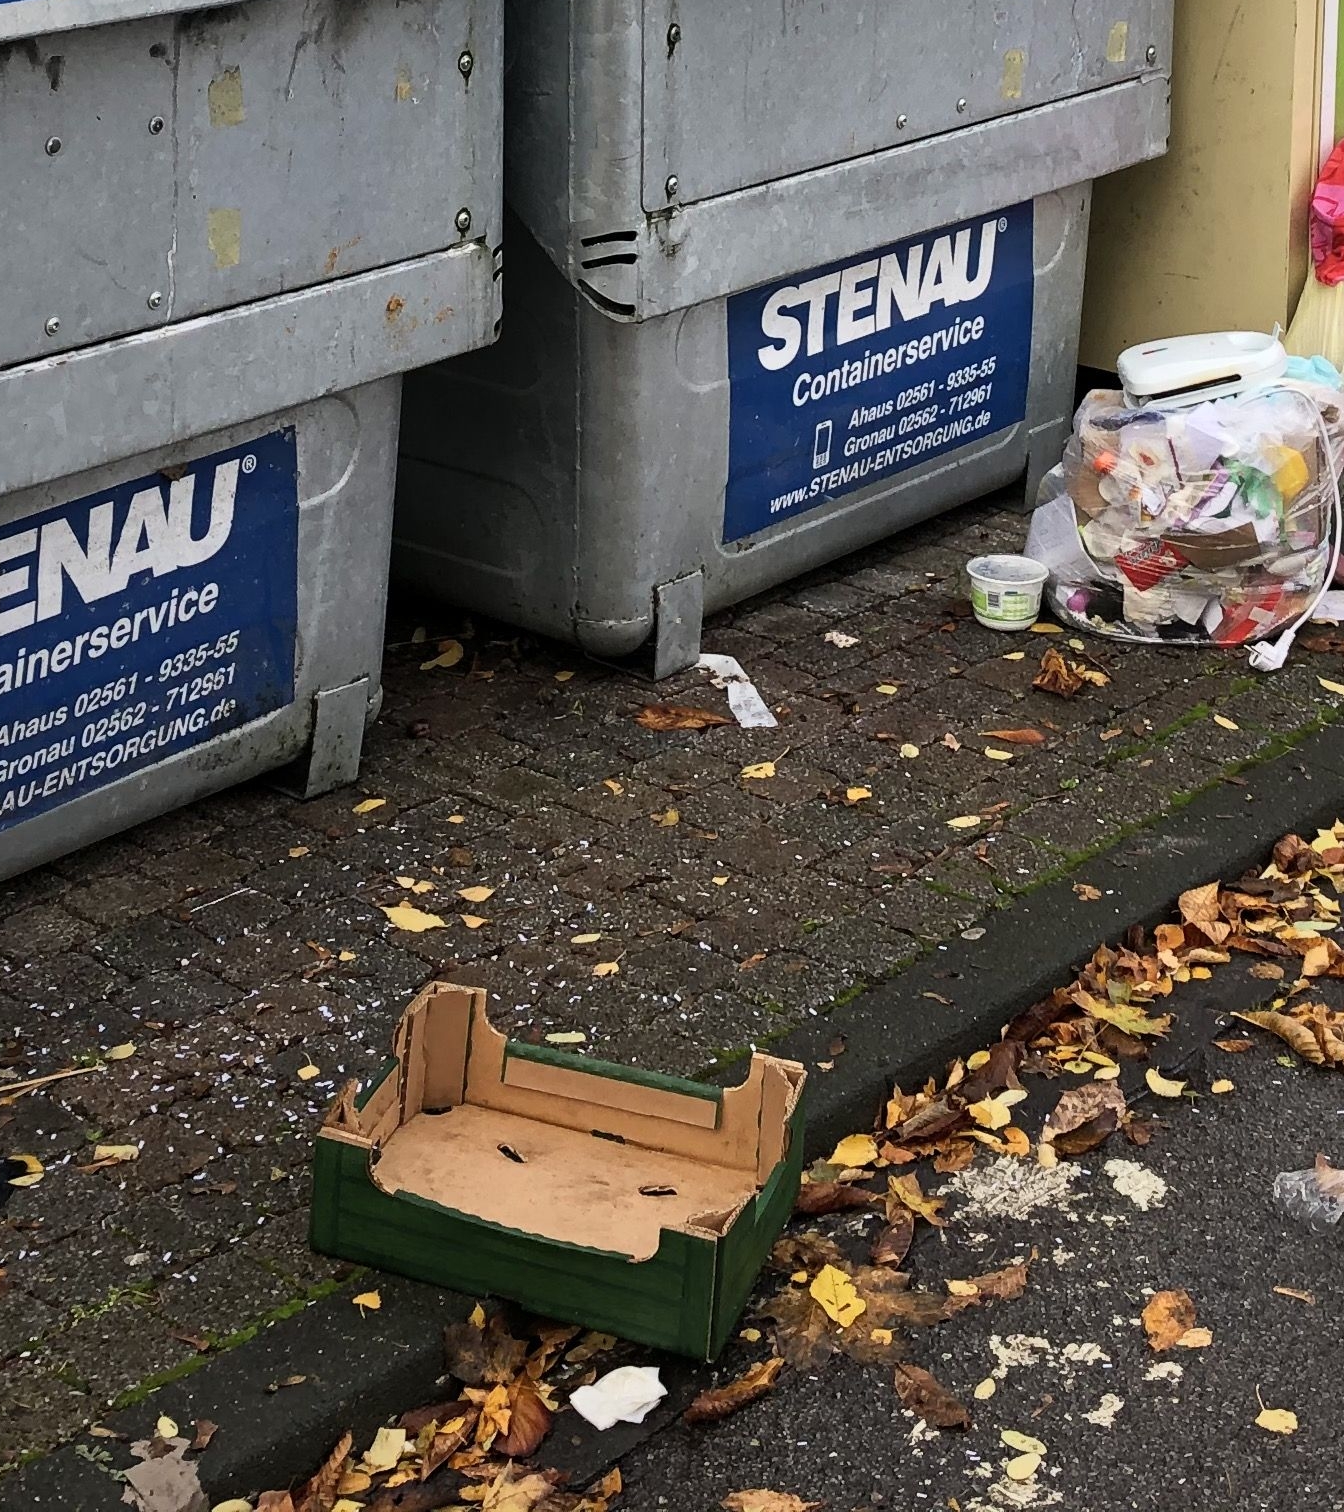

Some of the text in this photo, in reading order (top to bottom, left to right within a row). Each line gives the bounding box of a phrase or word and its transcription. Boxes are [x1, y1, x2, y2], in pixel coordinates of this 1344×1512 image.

[792, 315, 985, 408] Containerservice
[848, 399, 894, 430] Ahaus
[896, 379, 936, 411] 02561
[946, 355, 997, 392] 9335-55
[770, 410, 991, 514] www.STENAU-ENTSORGUNG.de
[844, 424, 895, 457] Gronau
[898, 404, 939, 436] 02562
[948, 381, 993, 416] 712961
[74, 672, 138, 718] 02561
[158, 630, 240, 683] 9335-55
[81, 701, 146, 748] 02562
[165, 663, 236, 712] 712961
